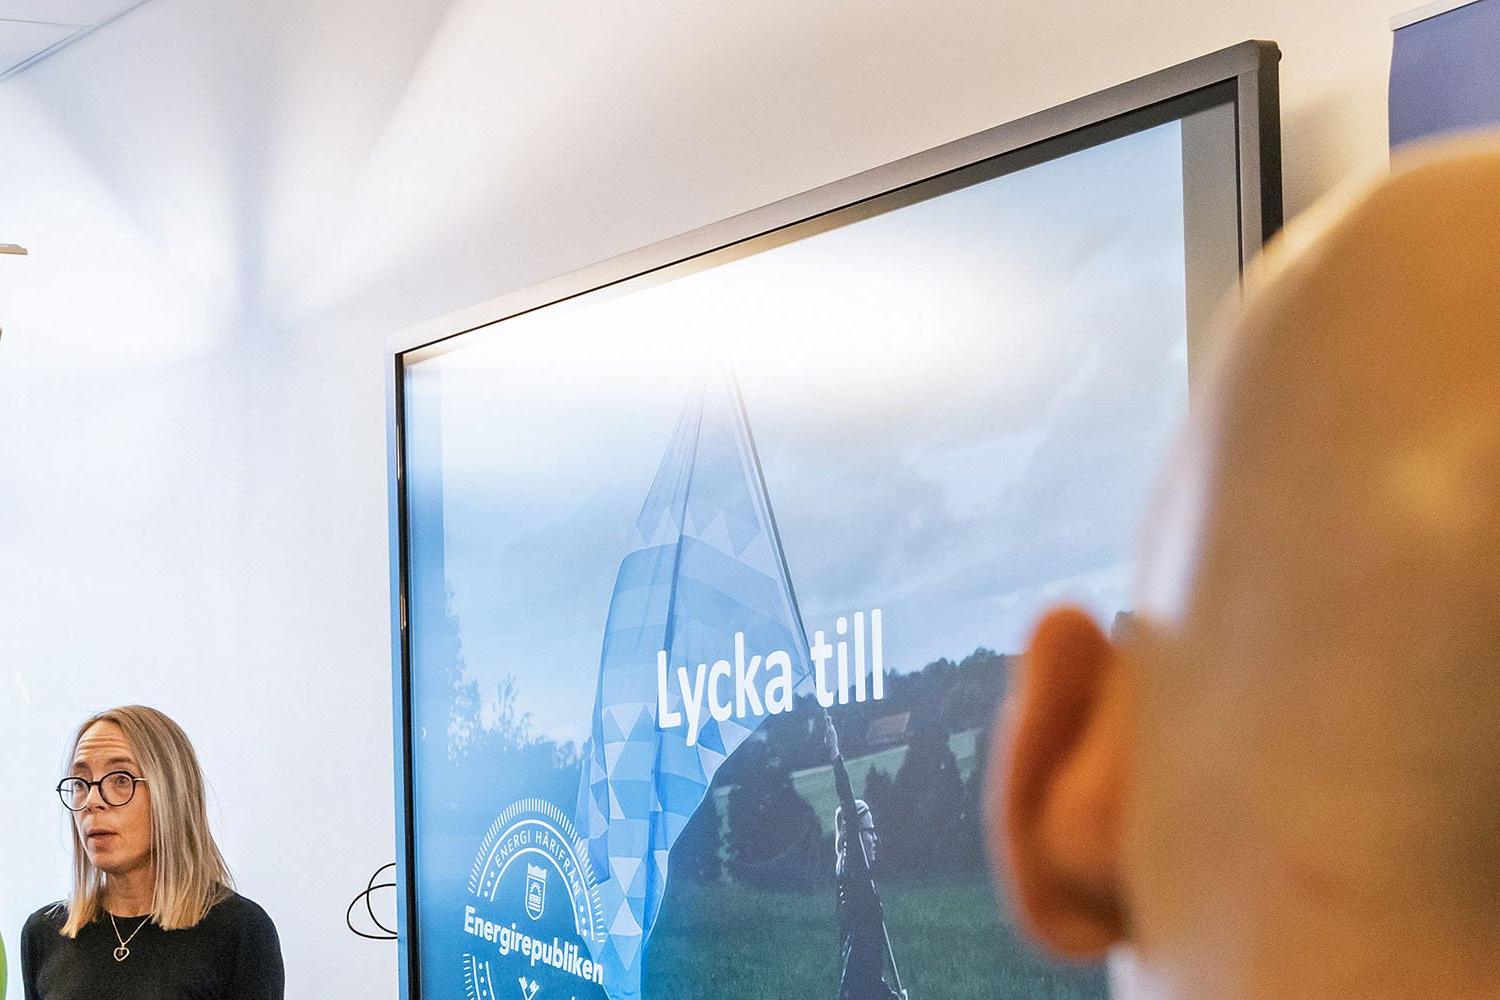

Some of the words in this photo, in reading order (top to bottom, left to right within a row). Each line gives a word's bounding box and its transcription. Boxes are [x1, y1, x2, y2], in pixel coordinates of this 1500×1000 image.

[657, 632, 793, 746] Lycka
[811, 609, 883, 707] till
[495, 830, 531, 868] ENERGI
[465, 905, 603, 985] Energirepubliken
